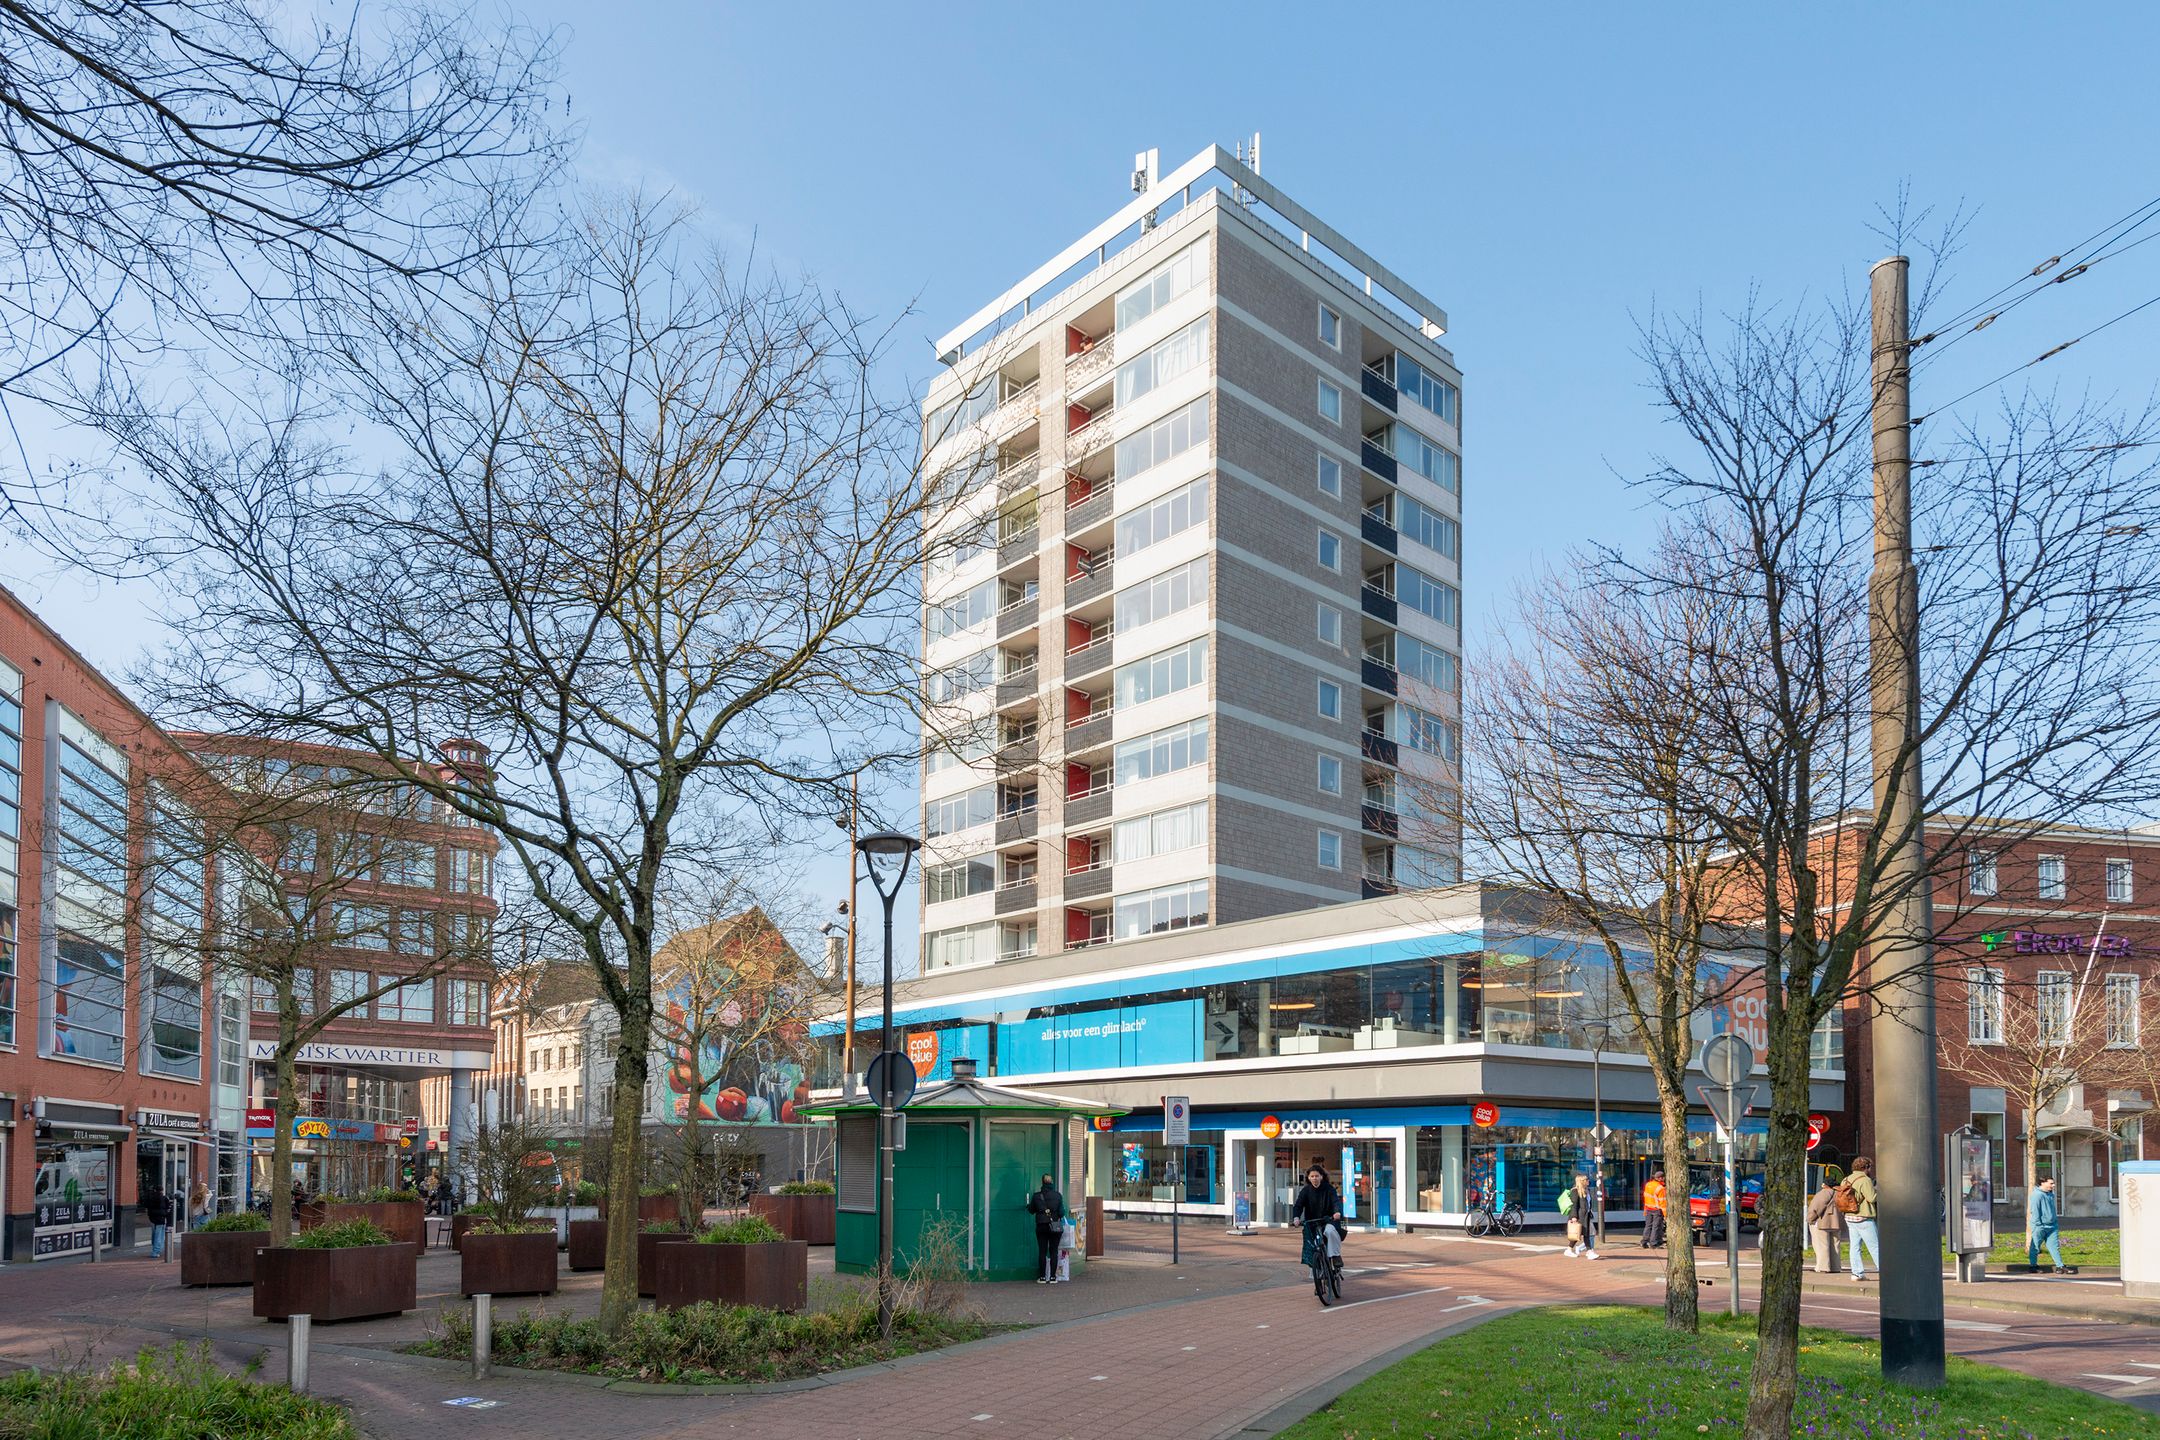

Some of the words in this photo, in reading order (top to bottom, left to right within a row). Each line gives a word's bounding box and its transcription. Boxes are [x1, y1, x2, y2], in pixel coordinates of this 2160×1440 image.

[1041, 1028, 1061, 1041] alles
[1062, 1026, 1083, 1039] voor
[1083, 1026, 1101, 1037] een
[910, 1035, 933, 1051] cool
[255, 1043, 443, 1065] MSISKWARTIER
[910, 1049, 933, 1063] blue
[1475, 1112, 1491, 1122] blue
[1478, 1107, 1493, 1117] cool
[149, 1113, 168, 1127] ZULA
[1281, 1119, 1351, 1134] COOLBLUE
[73, 1130, 88, 1139] ZULA
[299, 1122, 330, 1136] SMYTHS
[55, 1207, 70, 1216] ZULA
[92, 1204, 104, 1212] ZULA
